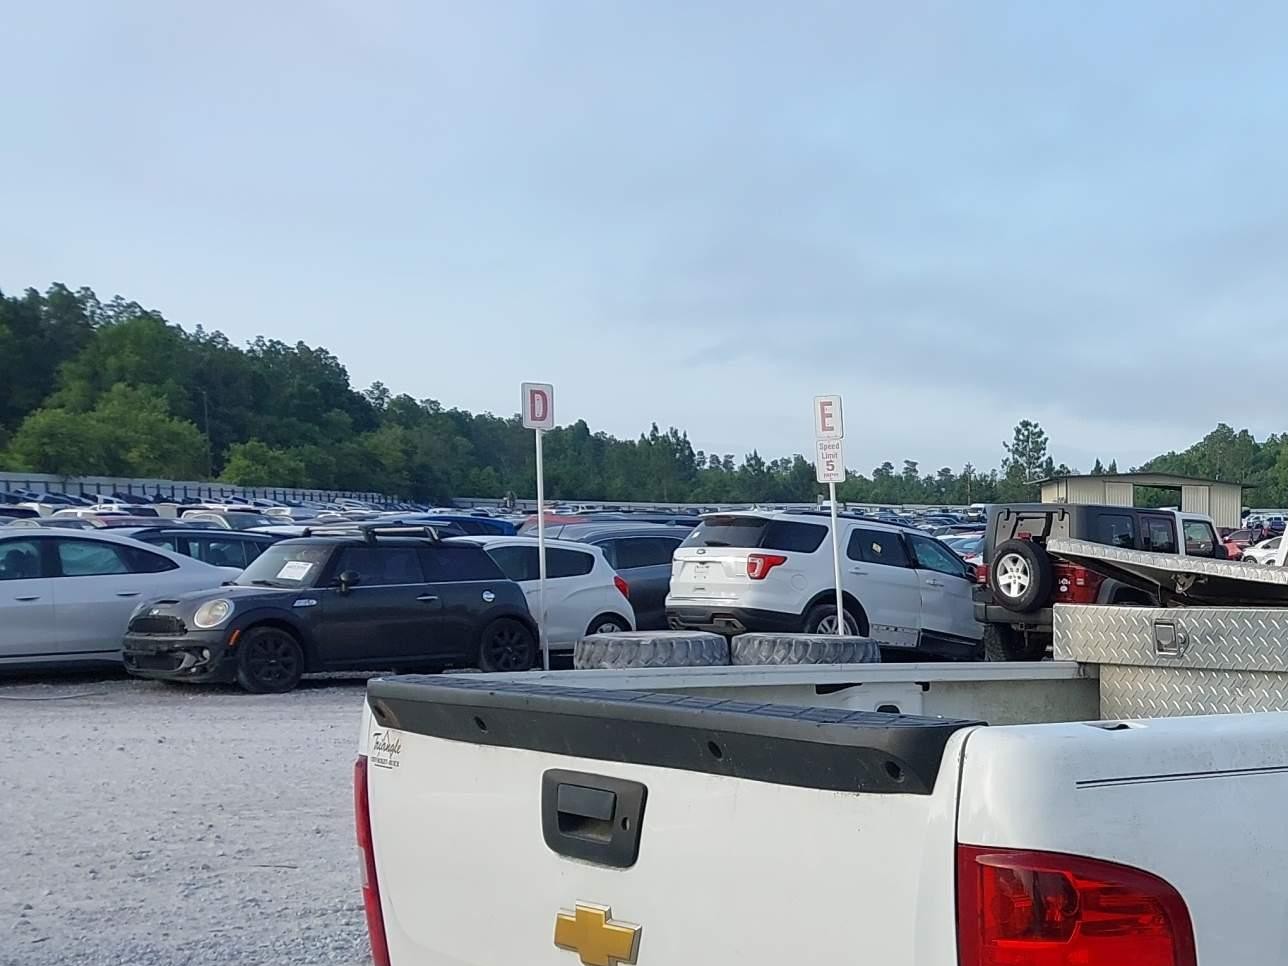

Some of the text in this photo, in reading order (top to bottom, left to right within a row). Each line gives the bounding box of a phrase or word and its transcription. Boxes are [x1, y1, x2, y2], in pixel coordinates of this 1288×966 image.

[530, 389, 548, 421] D
[820, 401, 834, 431] E
[819, 443, 840, 451] Speed
[825, 460, 835, 471] 5
